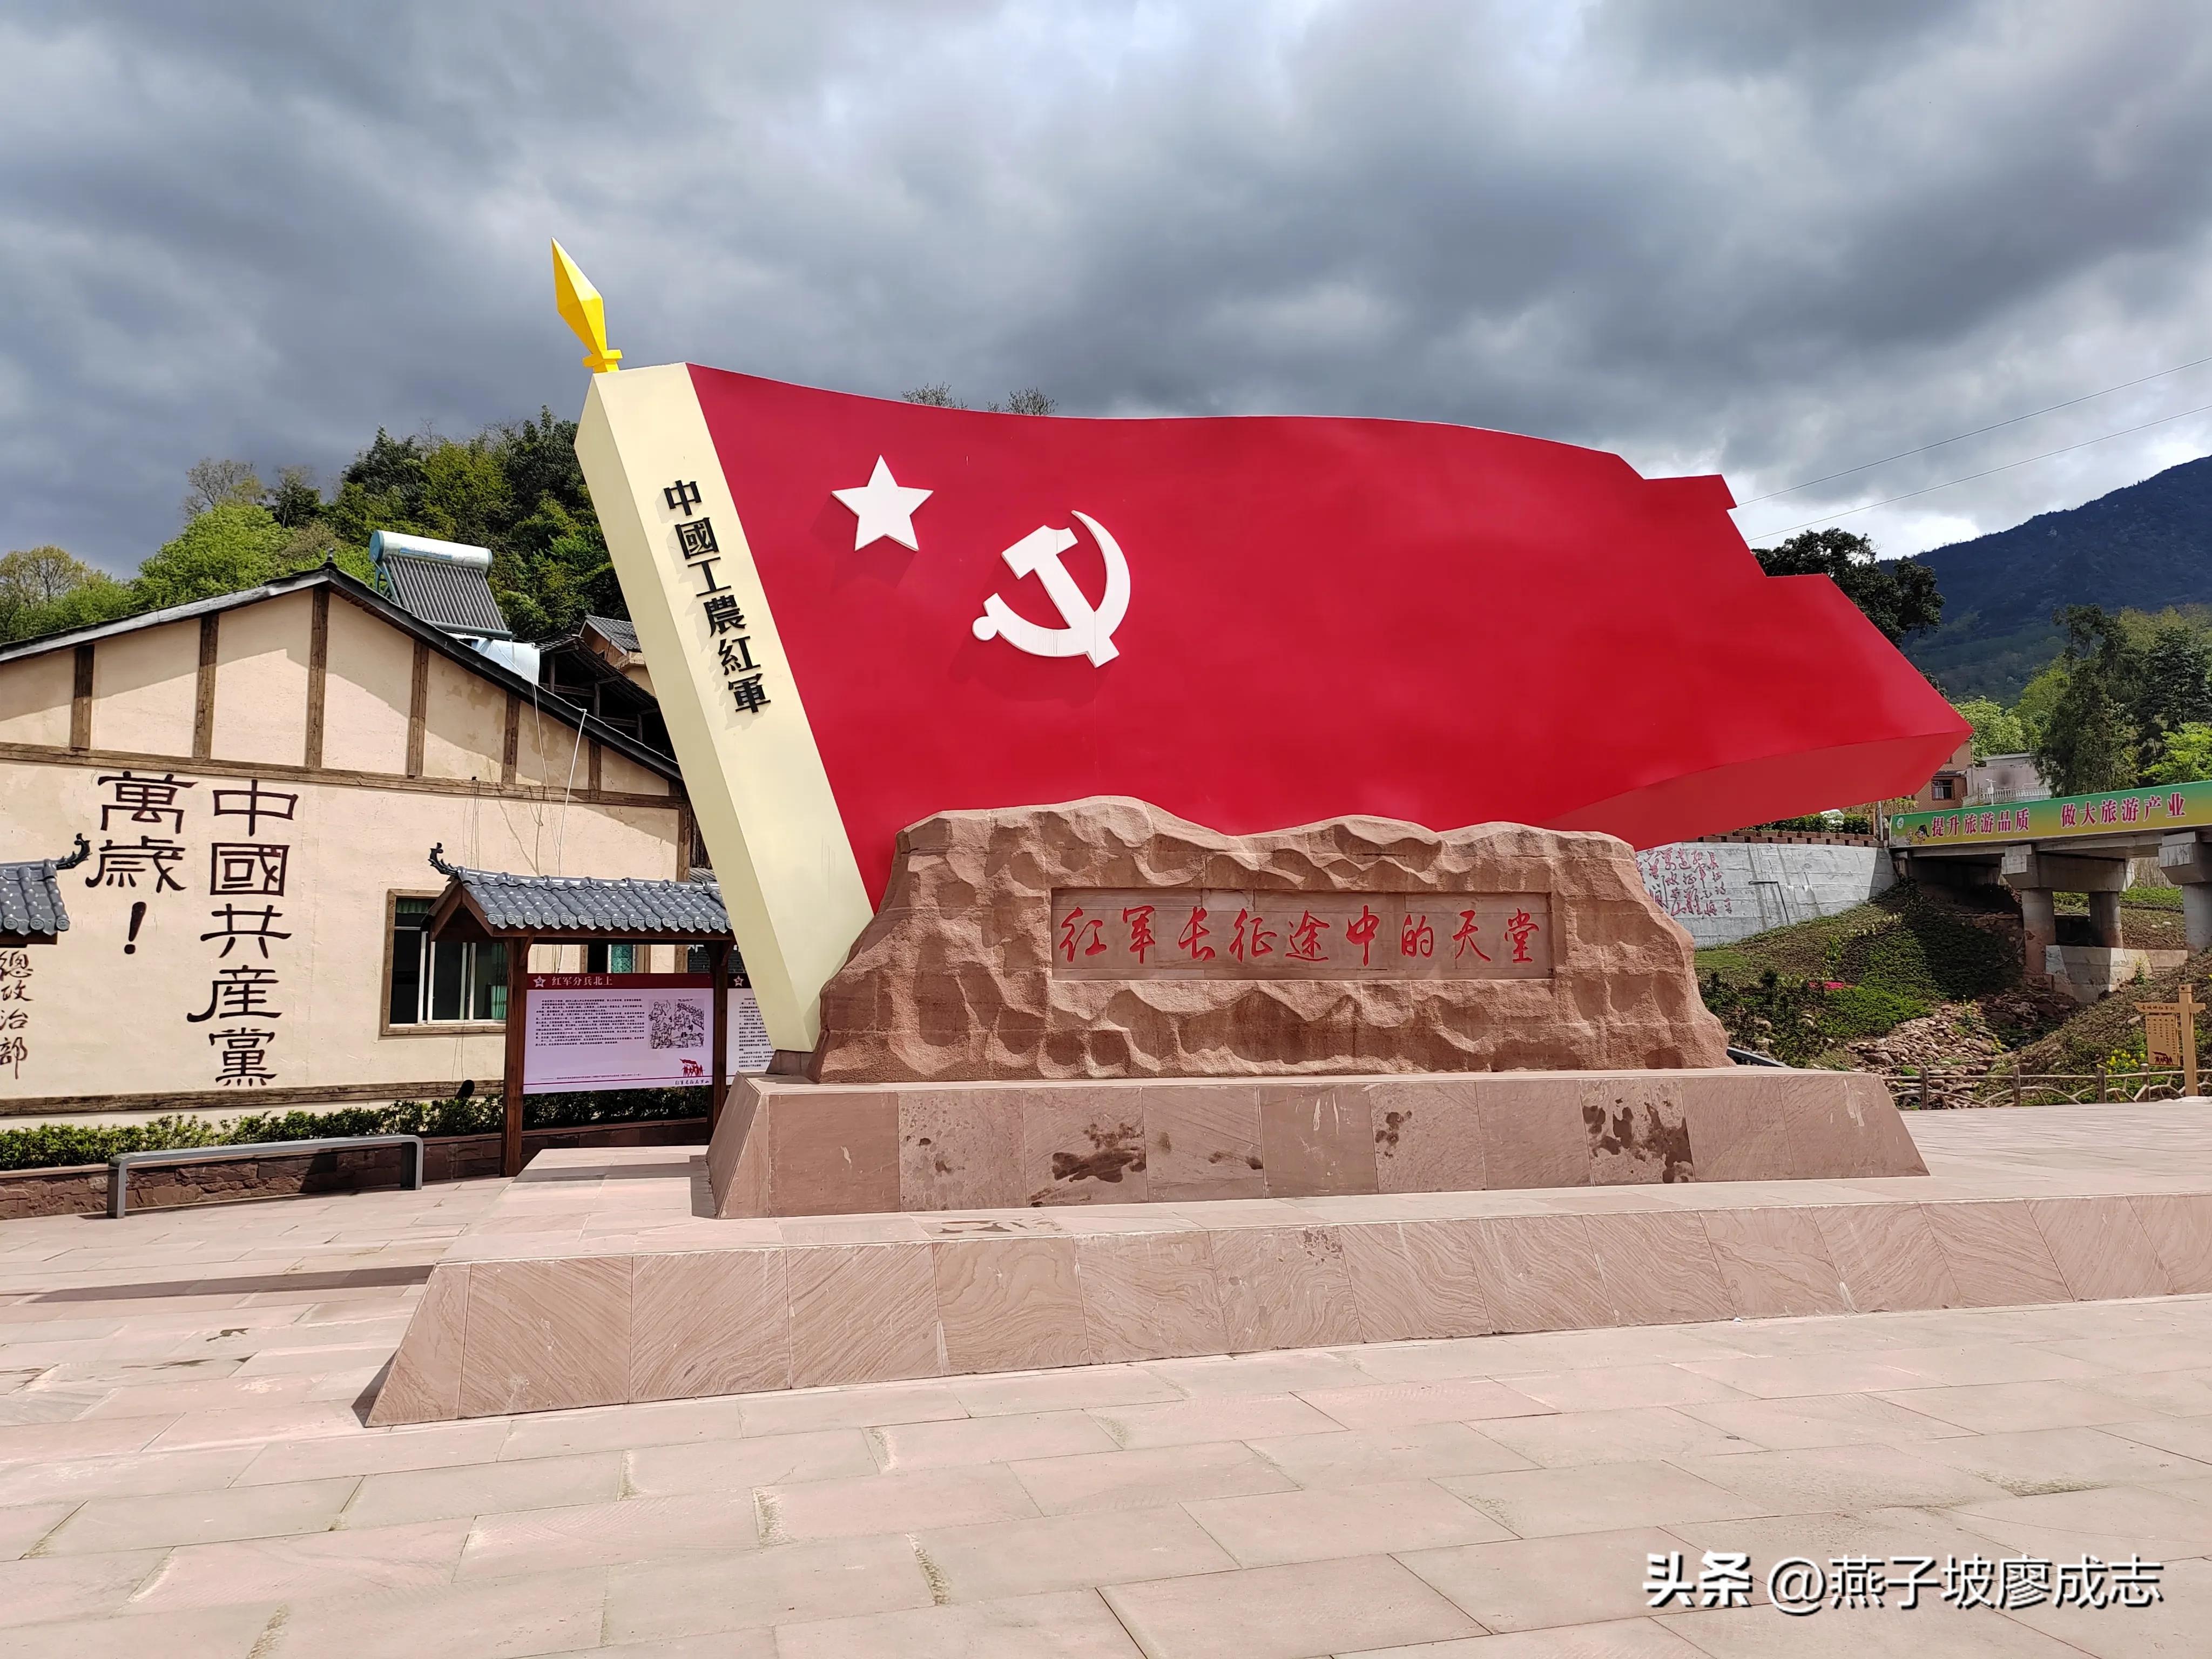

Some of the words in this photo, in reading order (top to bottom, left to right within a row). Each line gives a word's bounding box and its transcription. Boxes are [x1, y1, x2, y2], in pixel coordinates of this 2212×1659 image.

[664, 480, 771, 714] 中國工農紅軍
[1931, 807, 2031, 838] 提升旅游品质
[2060, 791, 2187, 830] 做大旅游产业
[1058, 903, 1541, 966] 红军长征途中的天堂
[551, 975, 613, 987] 红军分兵北上
